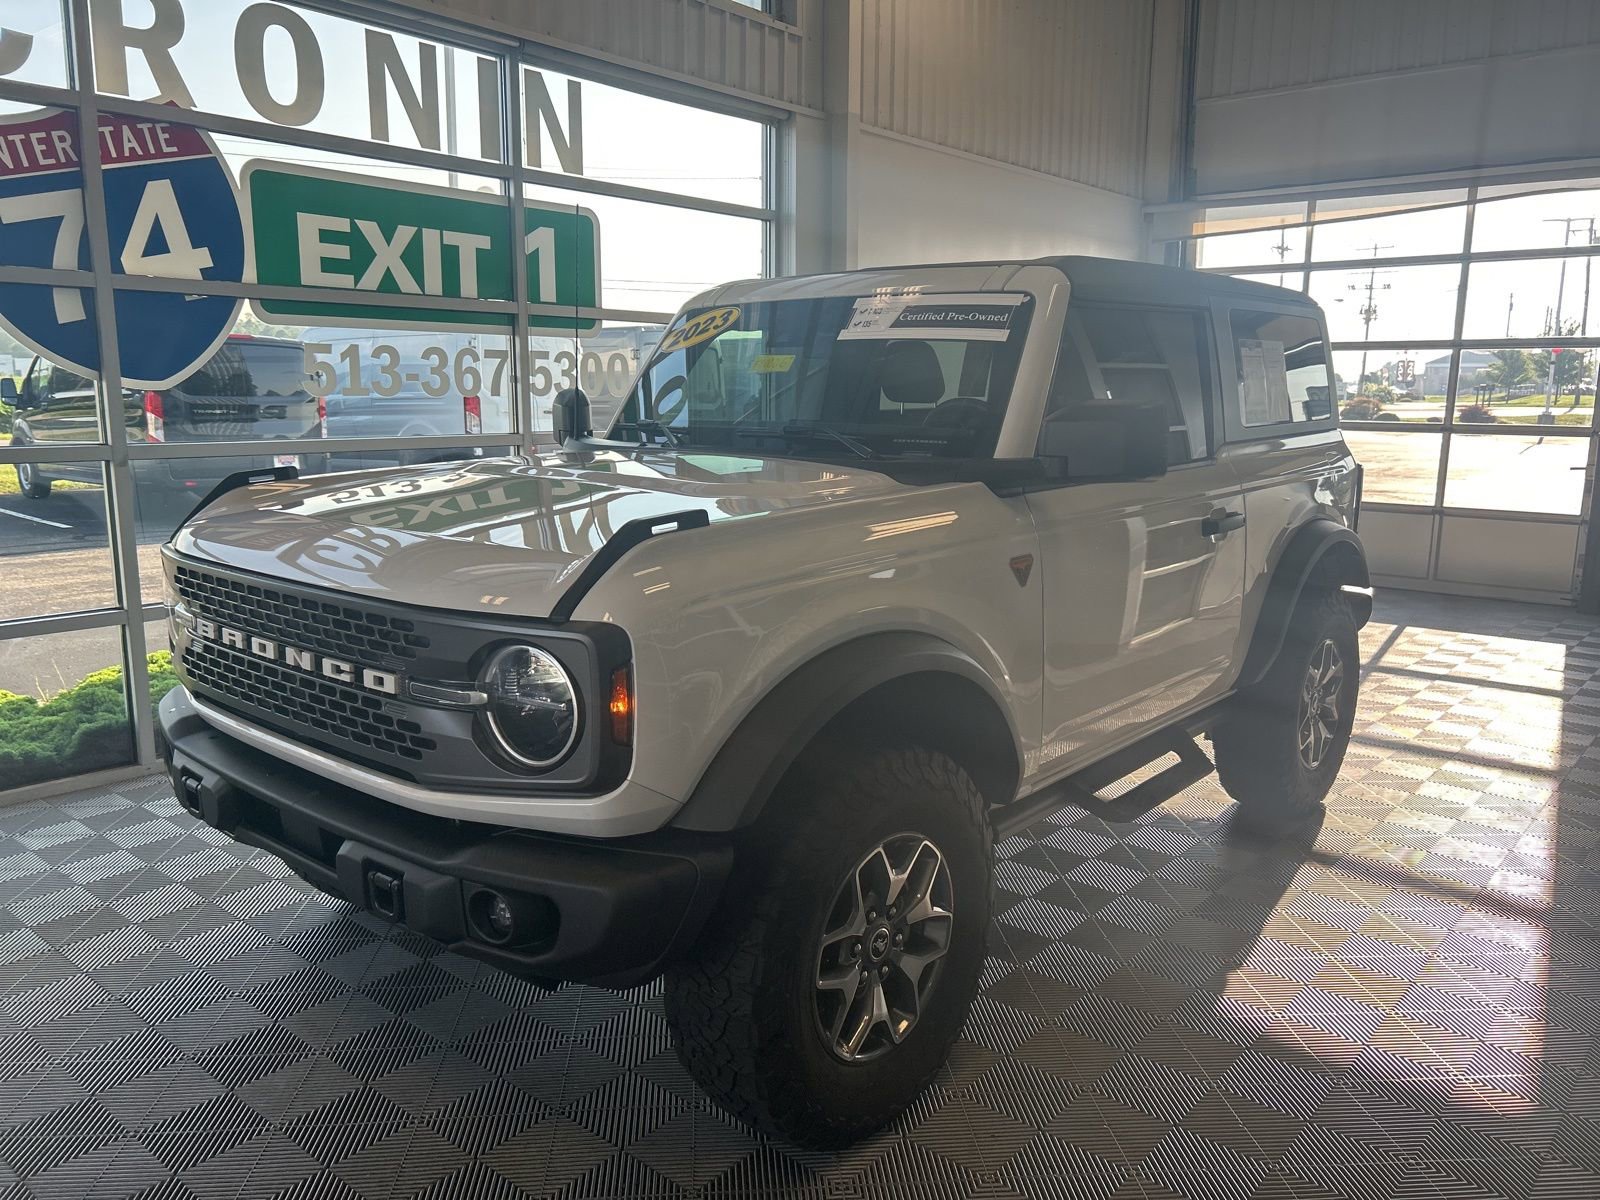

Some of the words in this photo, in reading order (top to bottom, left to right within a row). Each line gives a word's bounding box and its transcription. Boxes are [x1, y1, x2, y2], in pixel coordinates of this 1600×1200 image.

[0, 178, 214, 324] 74
[297, 212, 491, 298] EXIT
[525, 227, 557, 302] 1
[666, 309, 733, 349] 2023
[900, 312, 945, 321] Certified
[947, 312, 1009, 322] Pre-Owned
[301, 343, 630, 399] 513-3675300
[197, 617, 399, 695] BRONCO
